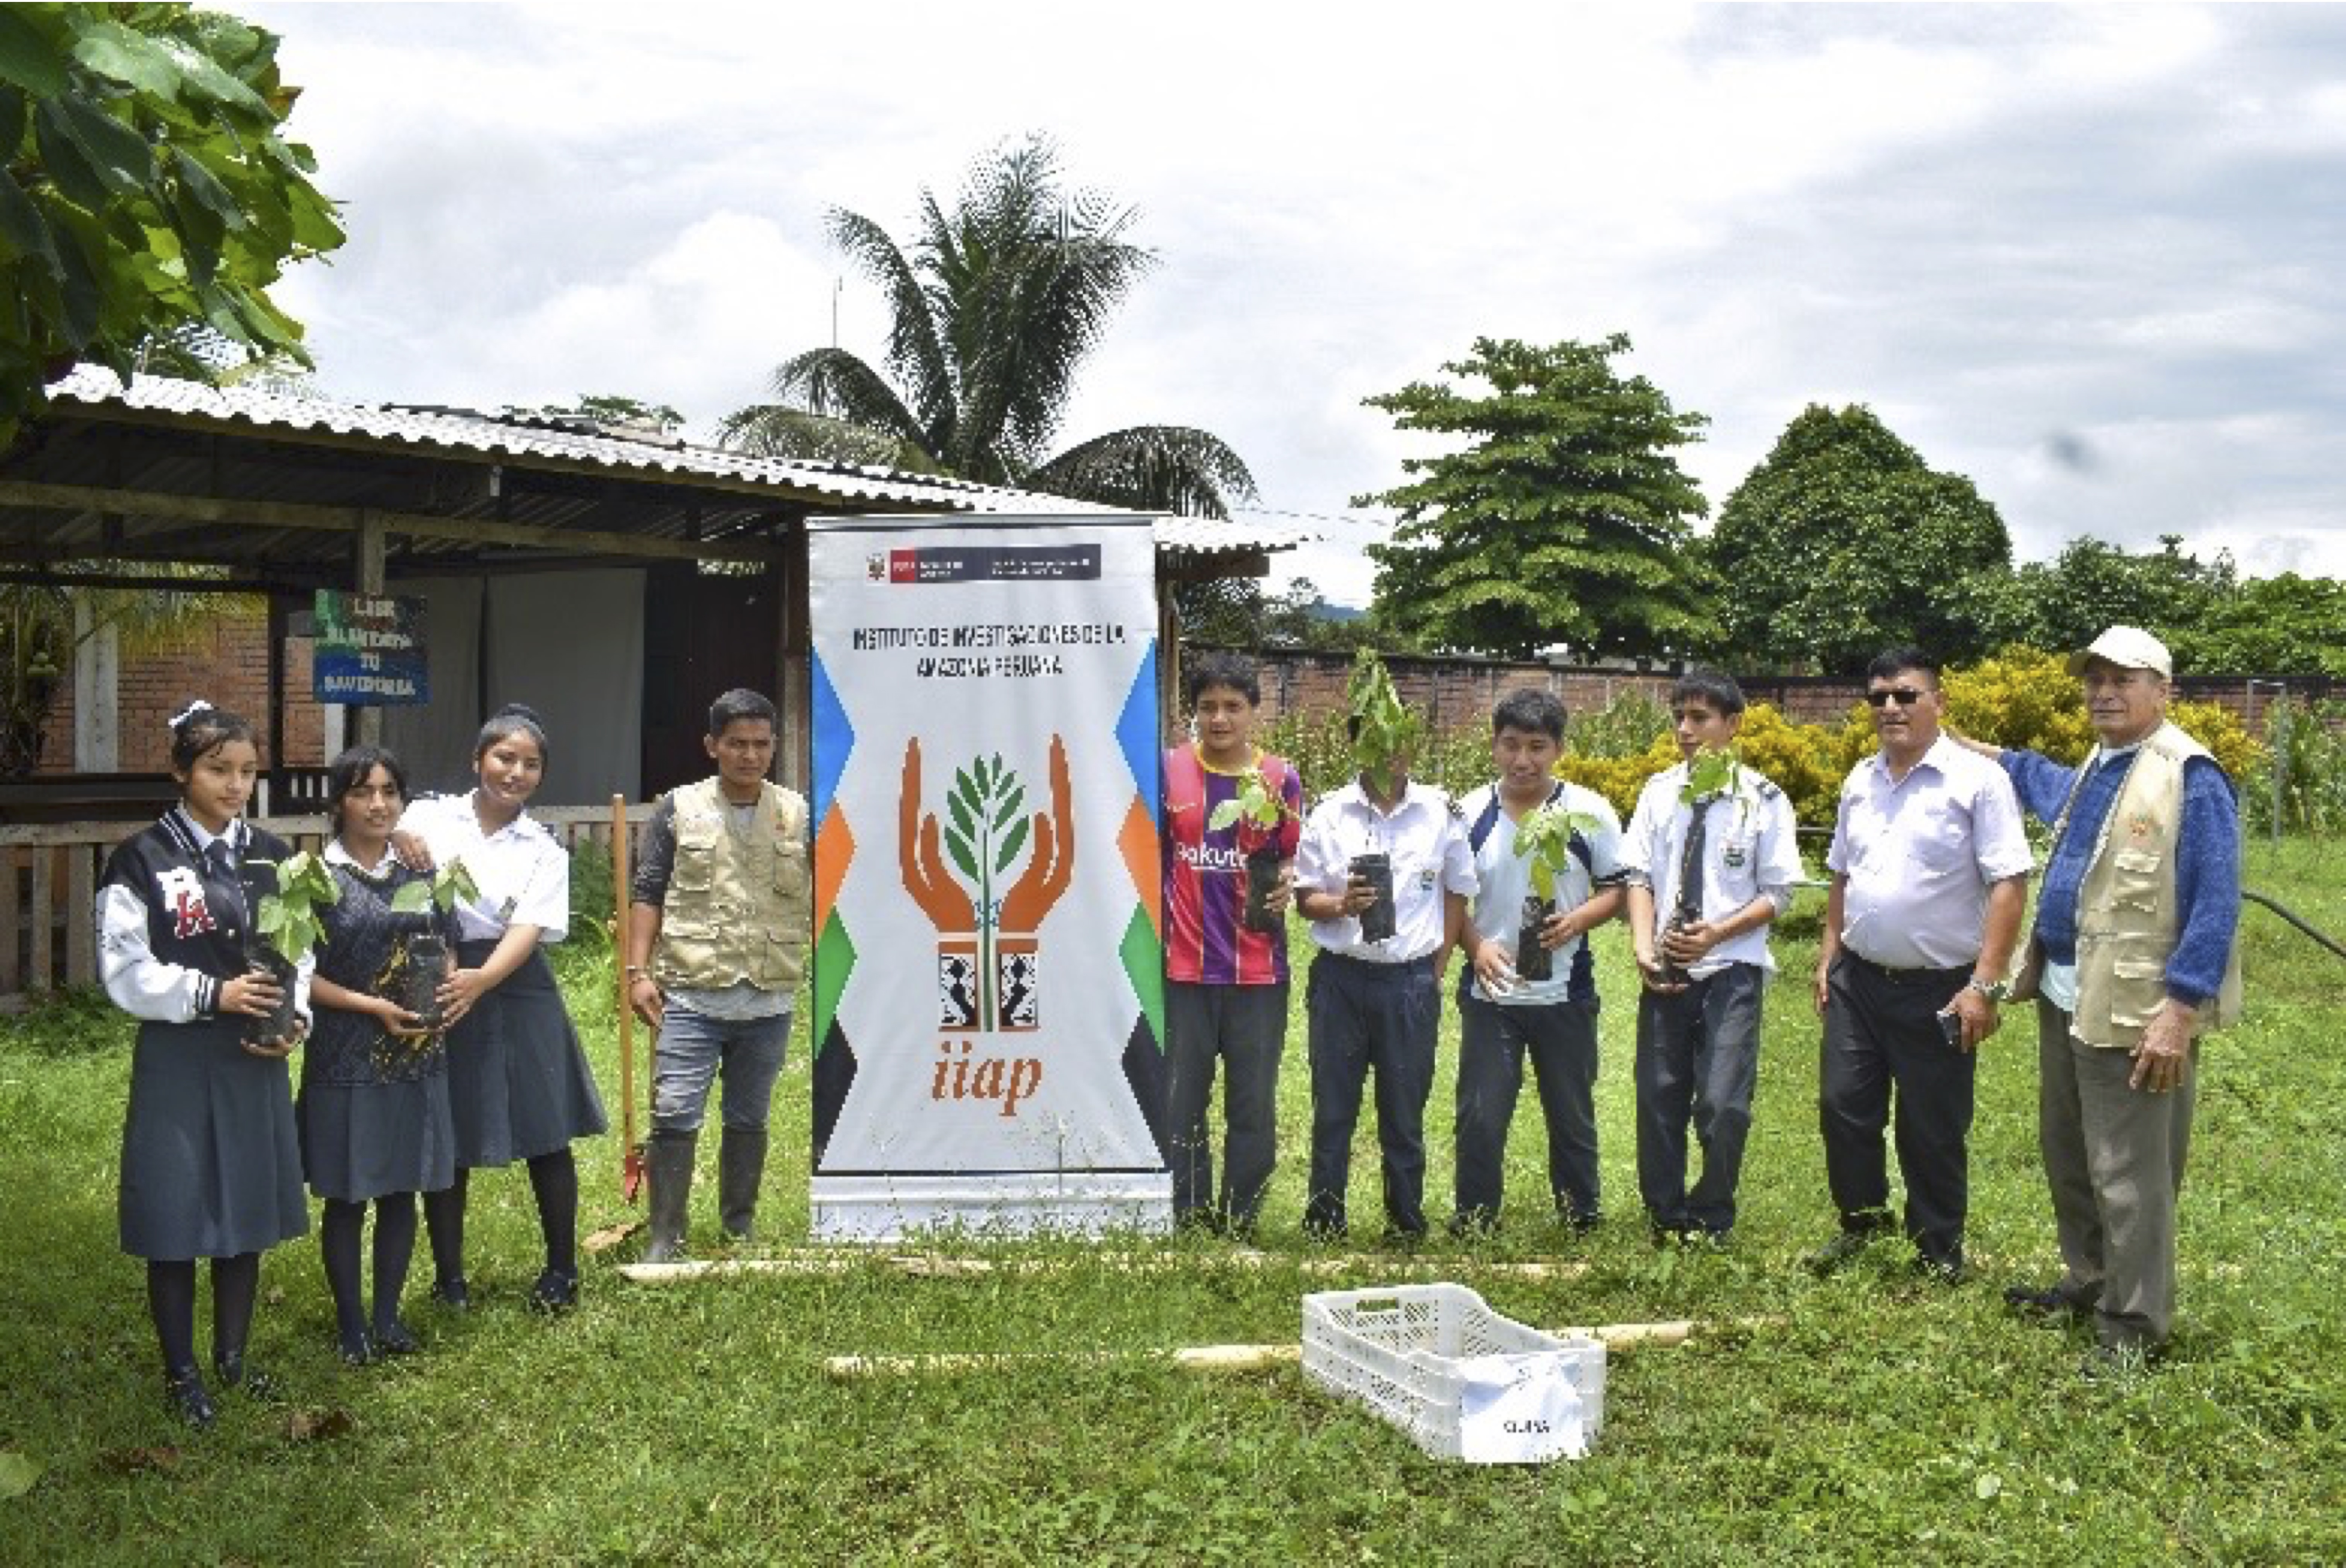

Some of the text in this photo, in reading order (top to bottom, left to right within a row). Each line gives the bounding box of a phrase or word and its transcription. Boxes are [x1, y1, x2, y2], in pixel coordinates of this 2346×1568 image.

[854, 628, 927, 650] INSTITUTO
[929, 628, 948, 647] DE
[953, 625, 1081, 647] INVESTIGACIONES
[1083, 625, 1102, 644] DE
[932, 1041, 1042, 1116] iiap
